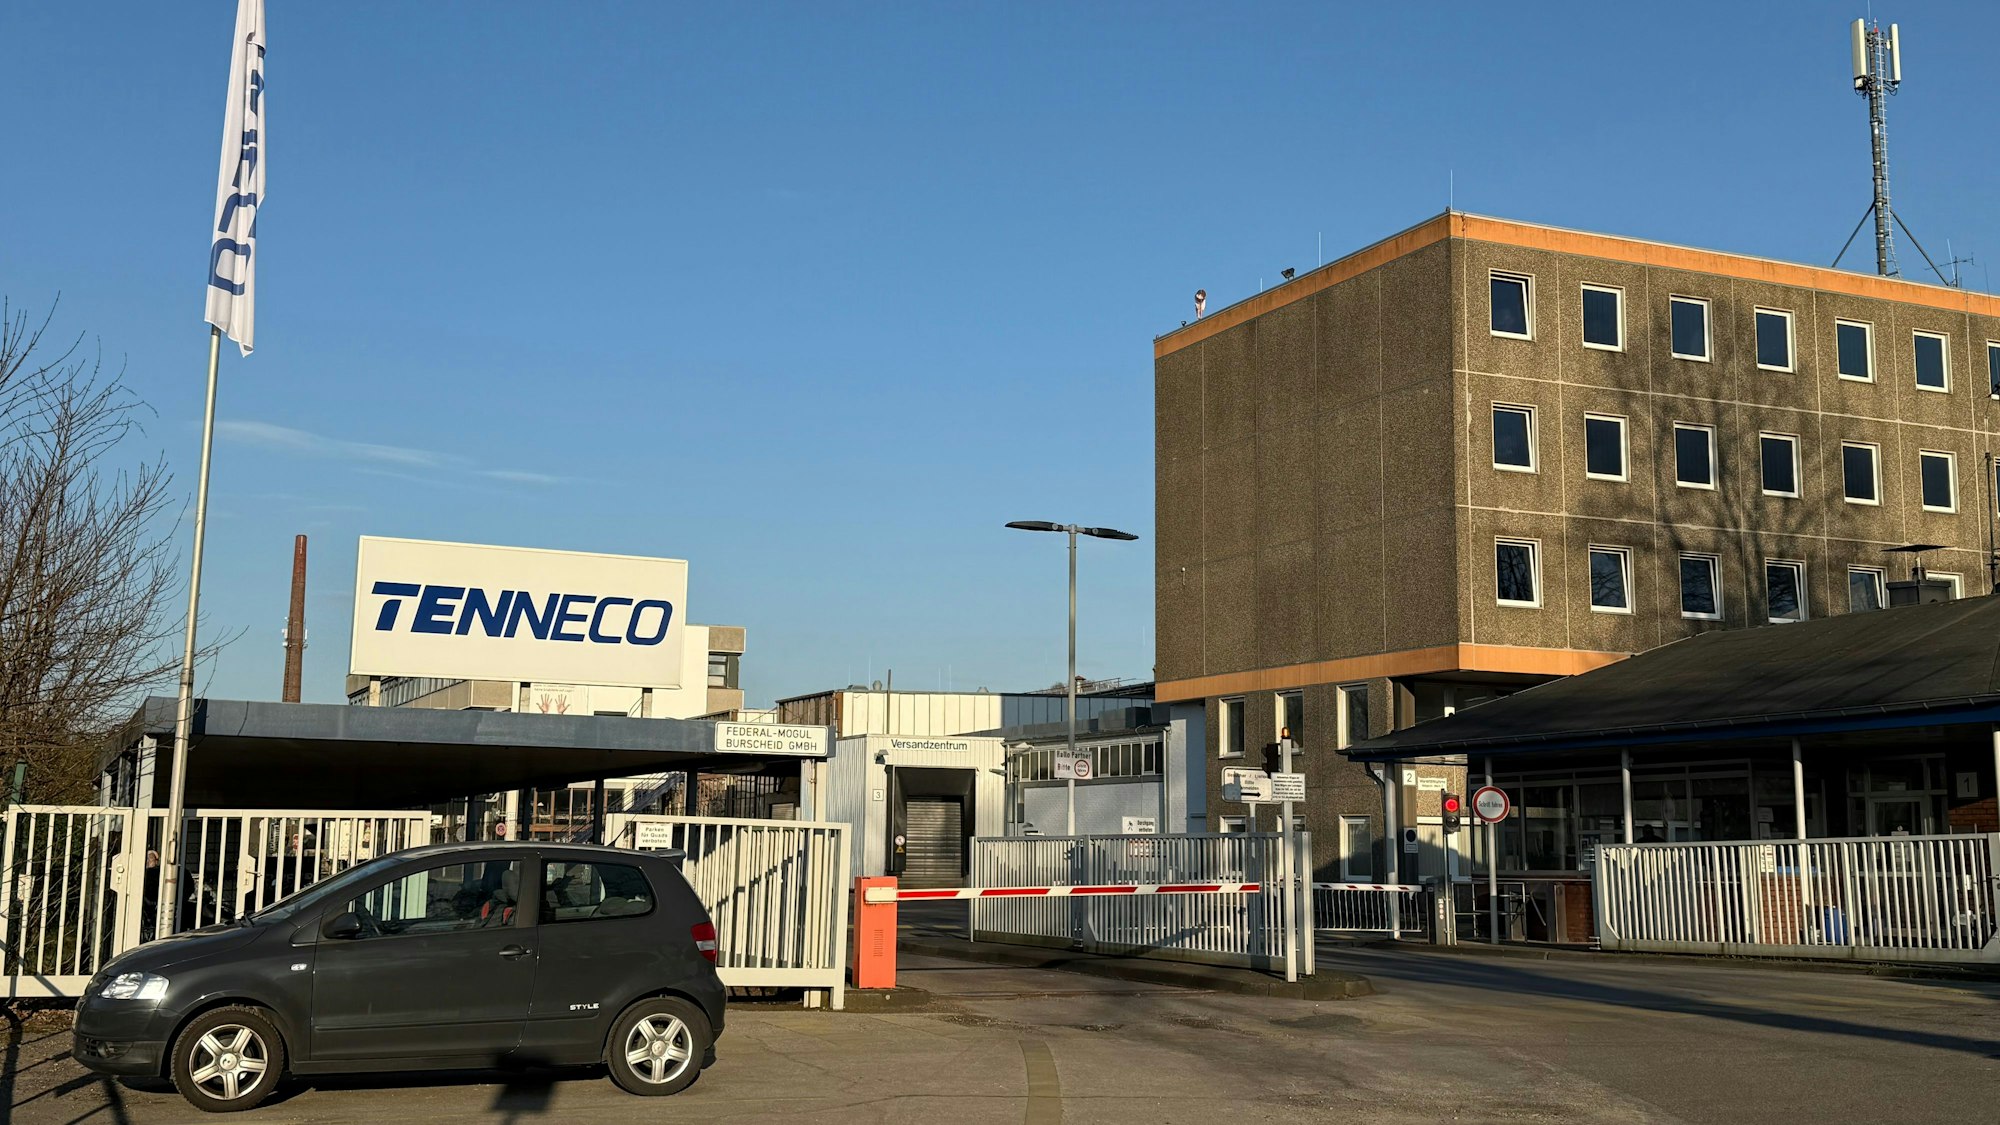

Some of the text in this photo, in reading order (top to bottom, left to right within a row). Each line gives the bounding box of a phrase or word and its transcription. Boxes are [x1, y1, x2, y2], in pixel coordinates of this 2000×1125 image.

[371, 581, 673, 646] TENNECO
[726, 726, 812, 739] FEDERAL-MOGUL
[726, 738, 817, 751] BURSCHEID GMBH
[891, 739, 968, 750] Versandzentrum
[1071, 751, 1091, 760] Partner
[1406, 773, 1413, 783] 2
[1963, 776, 1970, 793] 1
[875, 791, 881, 799] 3
[640, 831, 649, 839] für
[570, 1003, 599, 1011] STYLE
